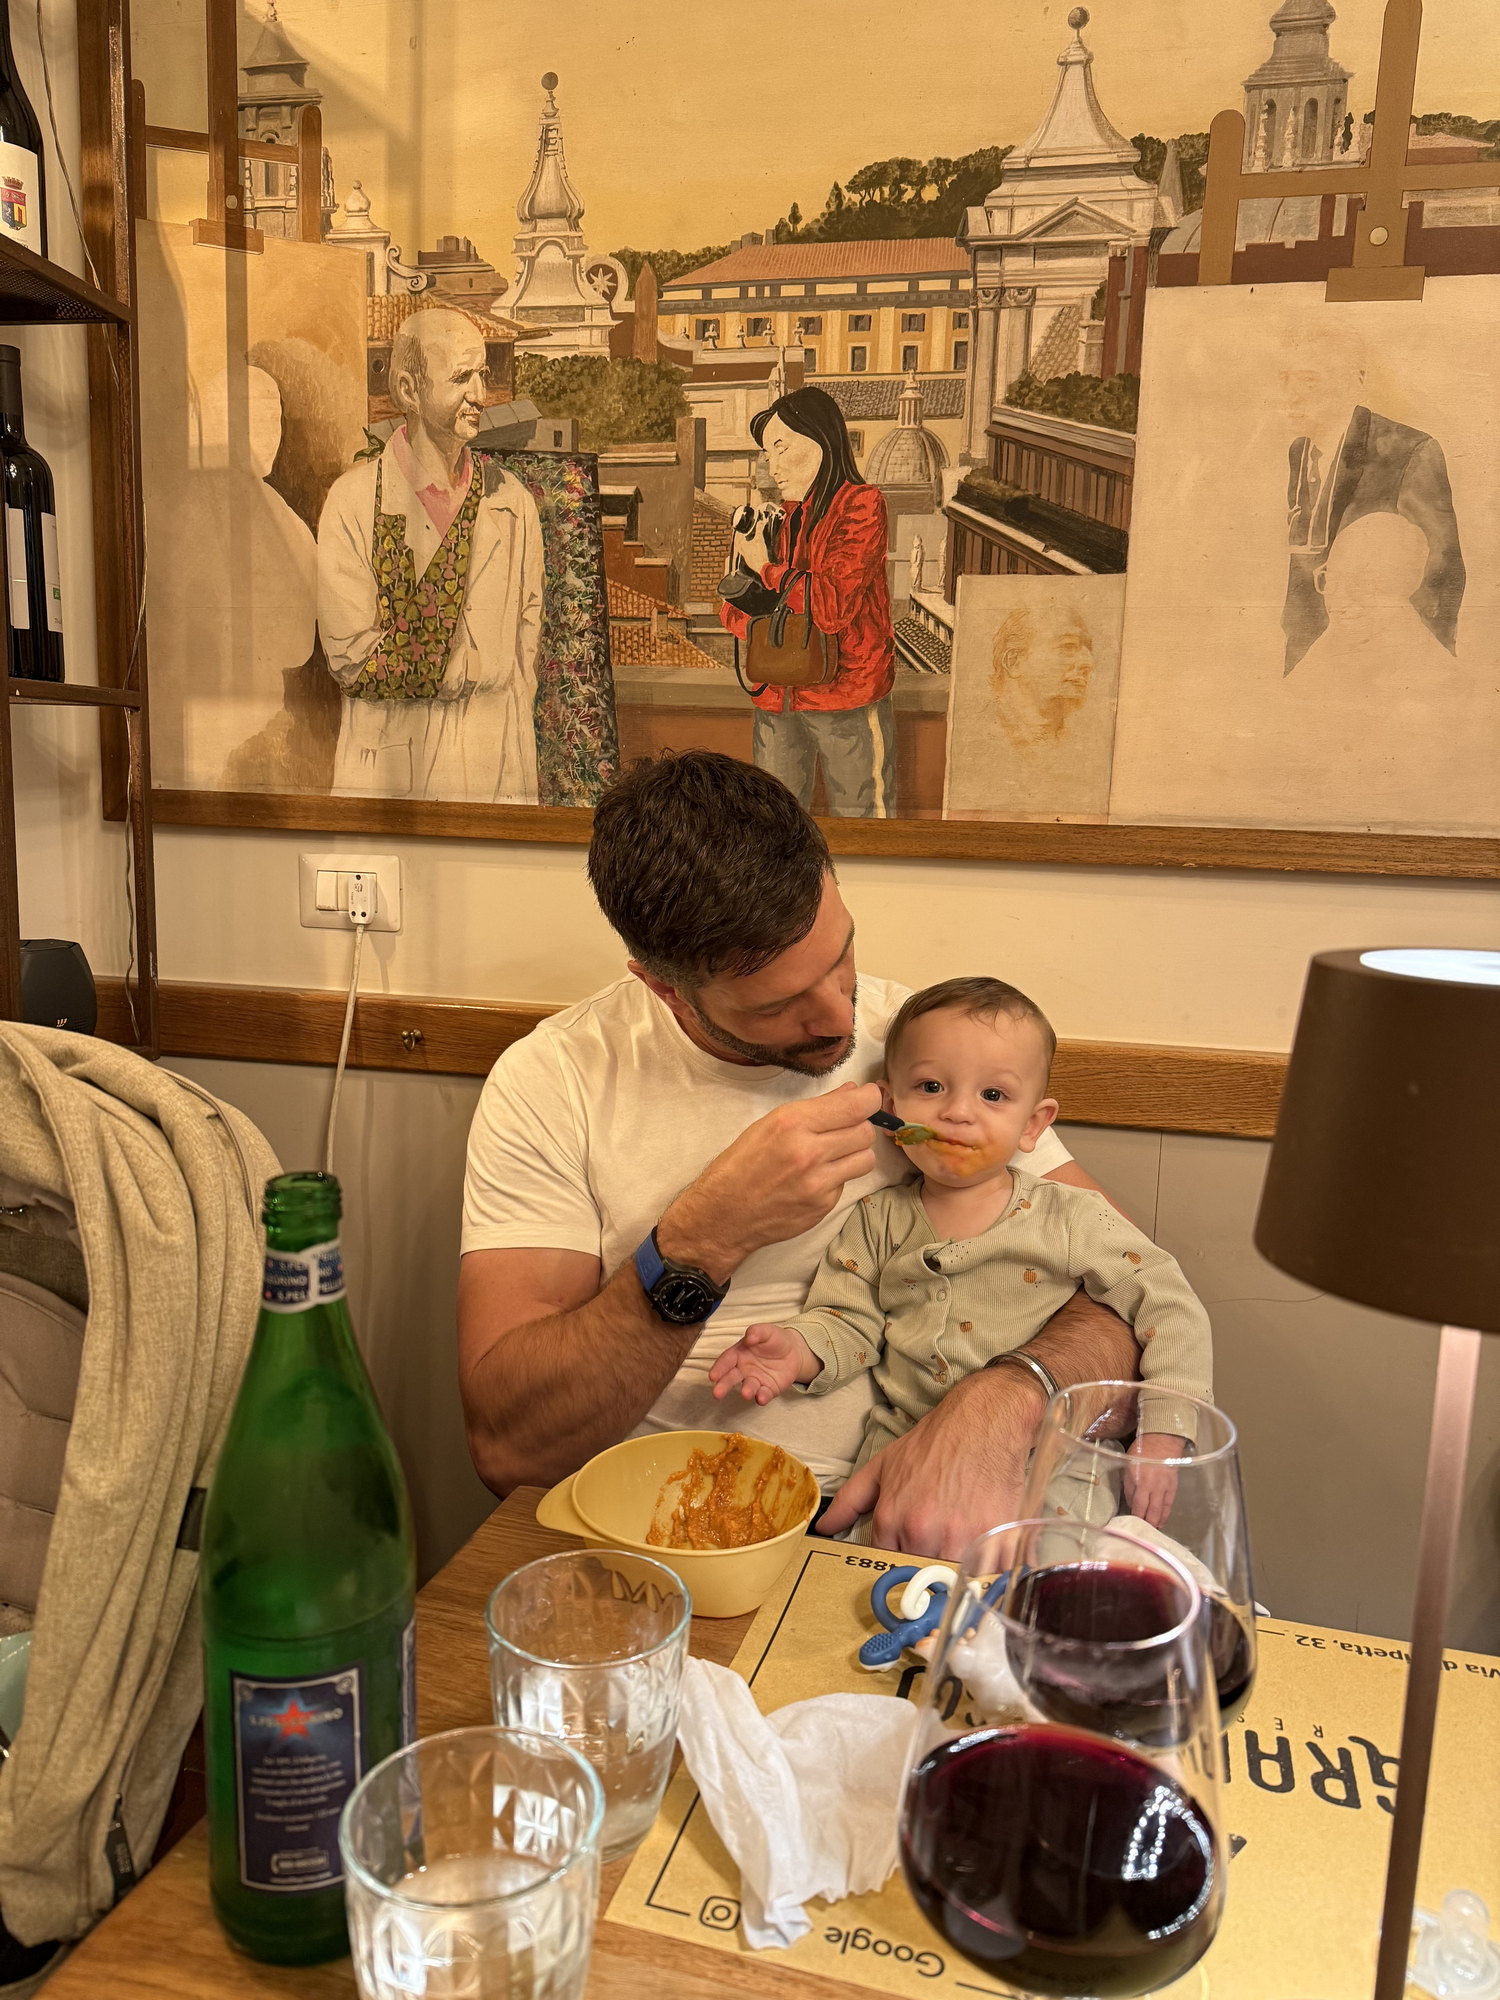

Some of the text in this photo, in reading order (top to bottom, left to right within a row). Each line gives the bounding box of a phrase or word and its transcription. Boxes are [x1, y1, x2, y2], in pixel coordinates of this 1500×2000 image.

[1294, 1634, 1326, 1650] 32
[1333, 1639, 1413, 1665] ipetta,
[1440, 1660, 1458, 1672] d
[824, 1926, 945, 1978] Google
